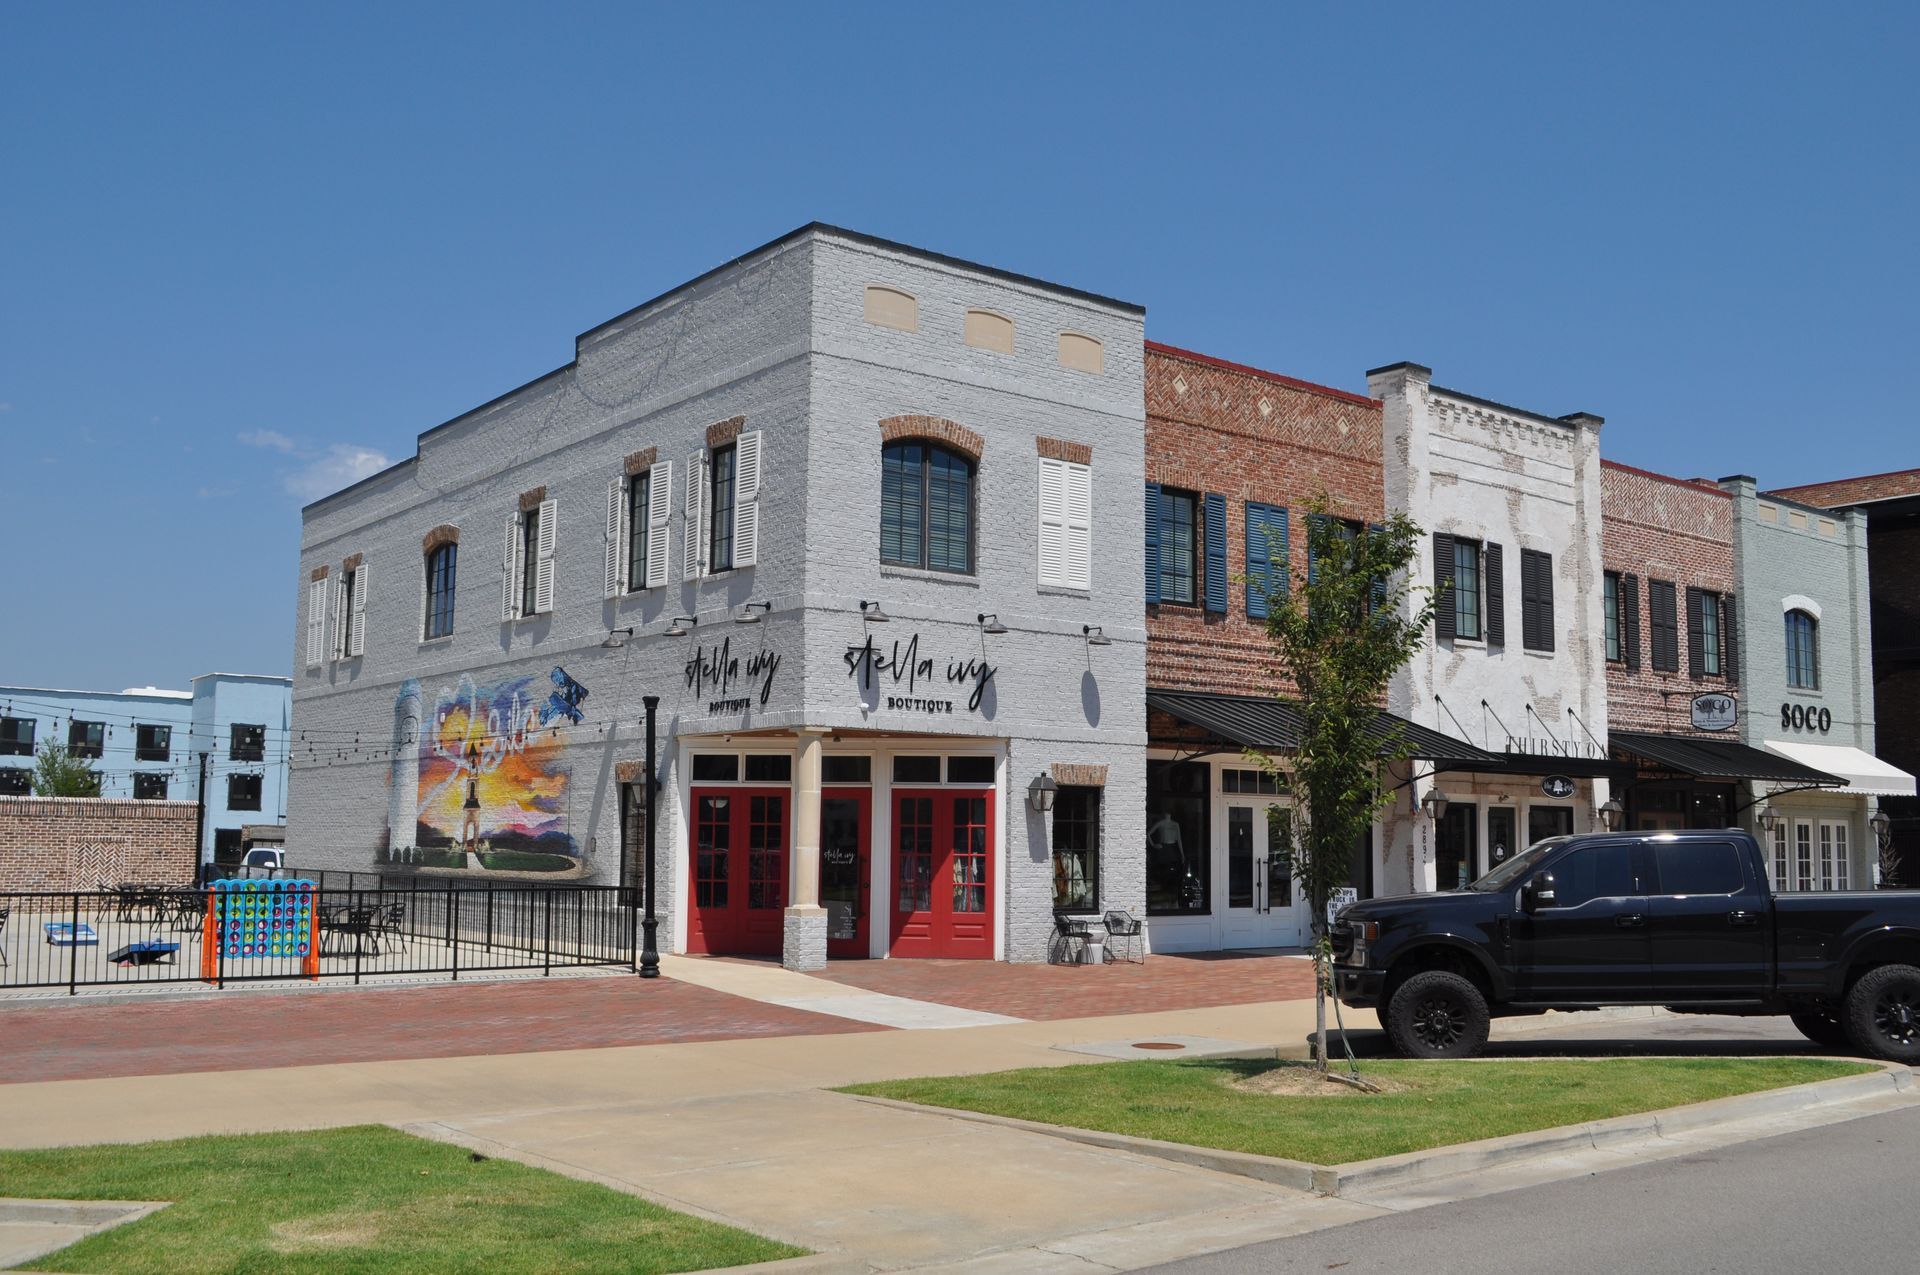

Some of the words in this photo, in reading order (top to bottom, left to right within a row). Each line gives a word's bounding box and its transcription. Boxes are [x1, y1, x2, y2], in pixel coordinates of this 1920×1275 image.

[685, 636, 738, 698] stella
[747, 649, 782, 704] ivy
[844, 633, 933, 695] stella
[947, 656, 998, 711] ivy
[709, 698, 751, 712] BOUTIQUE
[888, 697, 953, 713] BOUTIQUE
[1696, 699, 1732, 710] SOCO
[1781, 703, 1831, 732] SOCO
[1506, 736, 1581, 758] THIRSTY
